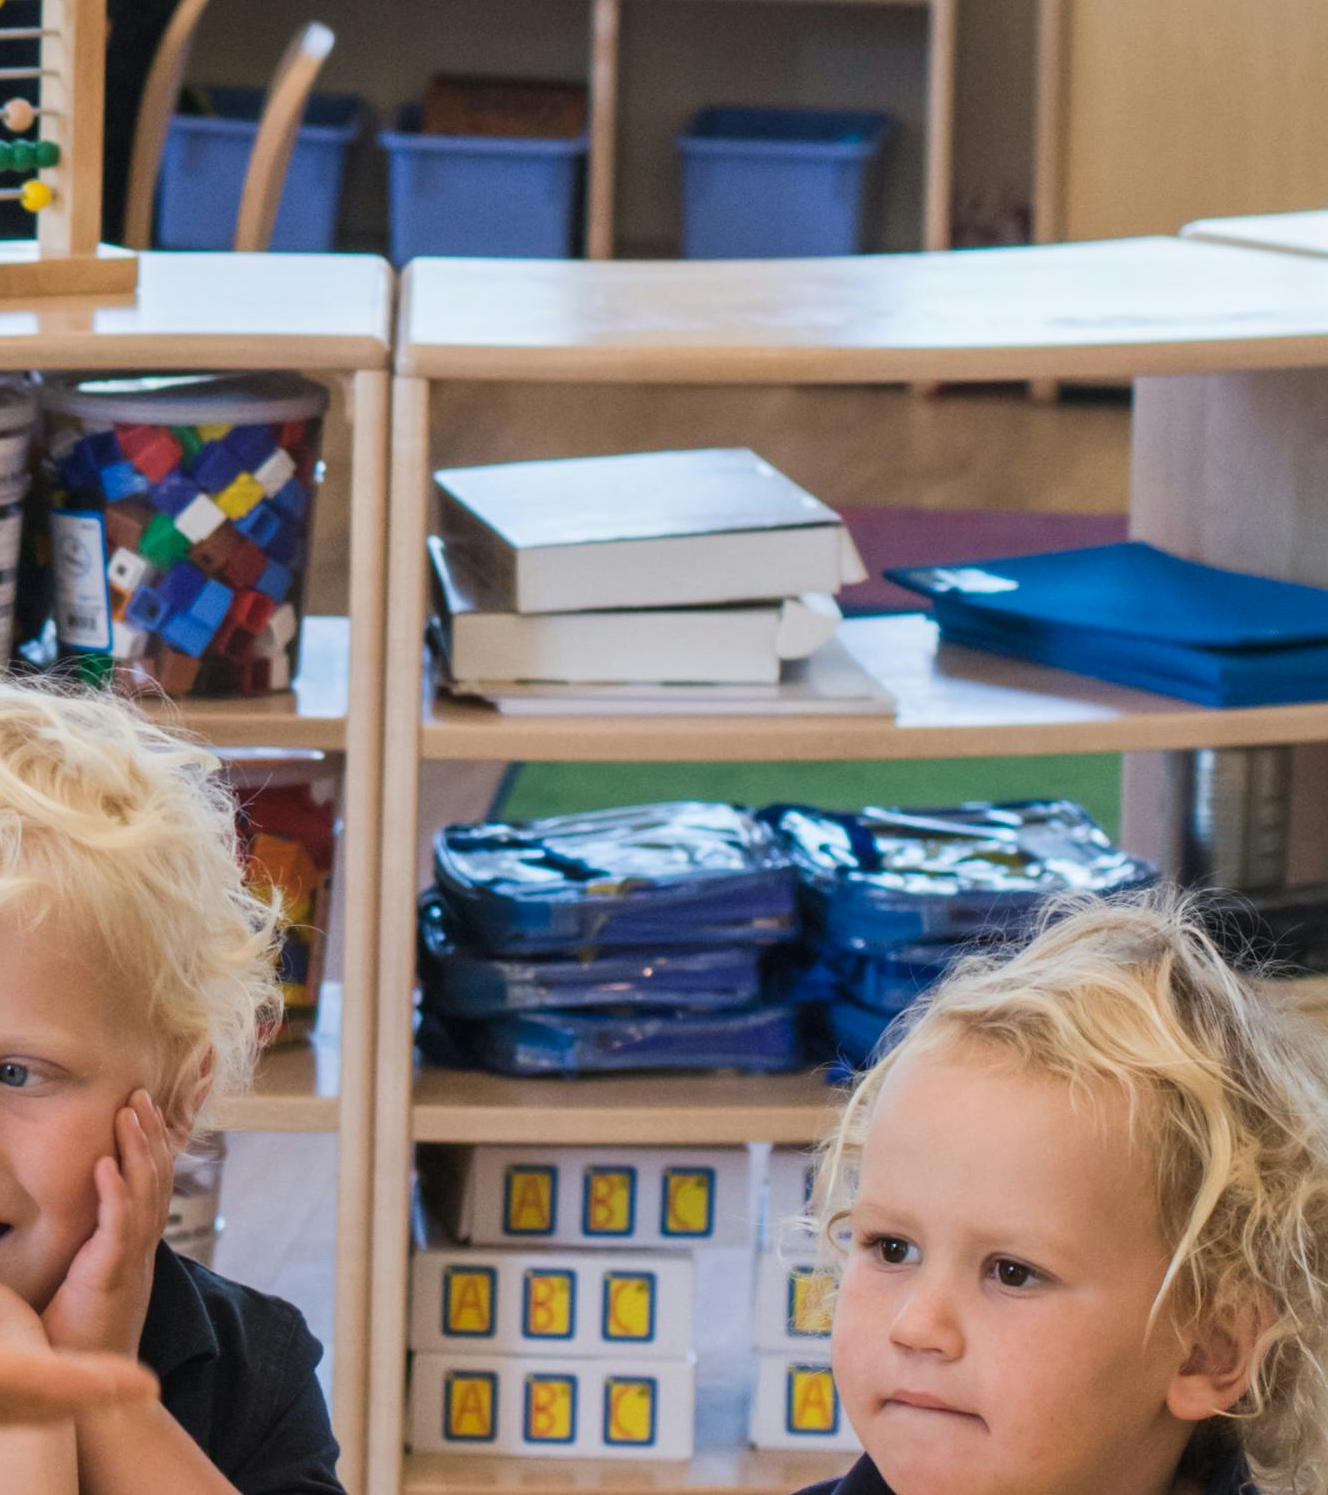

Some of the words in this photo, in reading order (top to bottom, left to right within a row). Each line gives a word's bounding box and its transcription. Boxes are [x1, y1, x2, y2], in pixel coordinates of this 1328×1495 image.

[511, 1175, 550, 1229] A
[588, 1173, 616, 1231] B
[449, 1276, 489, 1332] A
[529, 1276, 558, 1333] B
[451, 1381, 490, 1437] A
[530, 1381, 558, 1438] B
[795, 1377, 832, 1430] A
